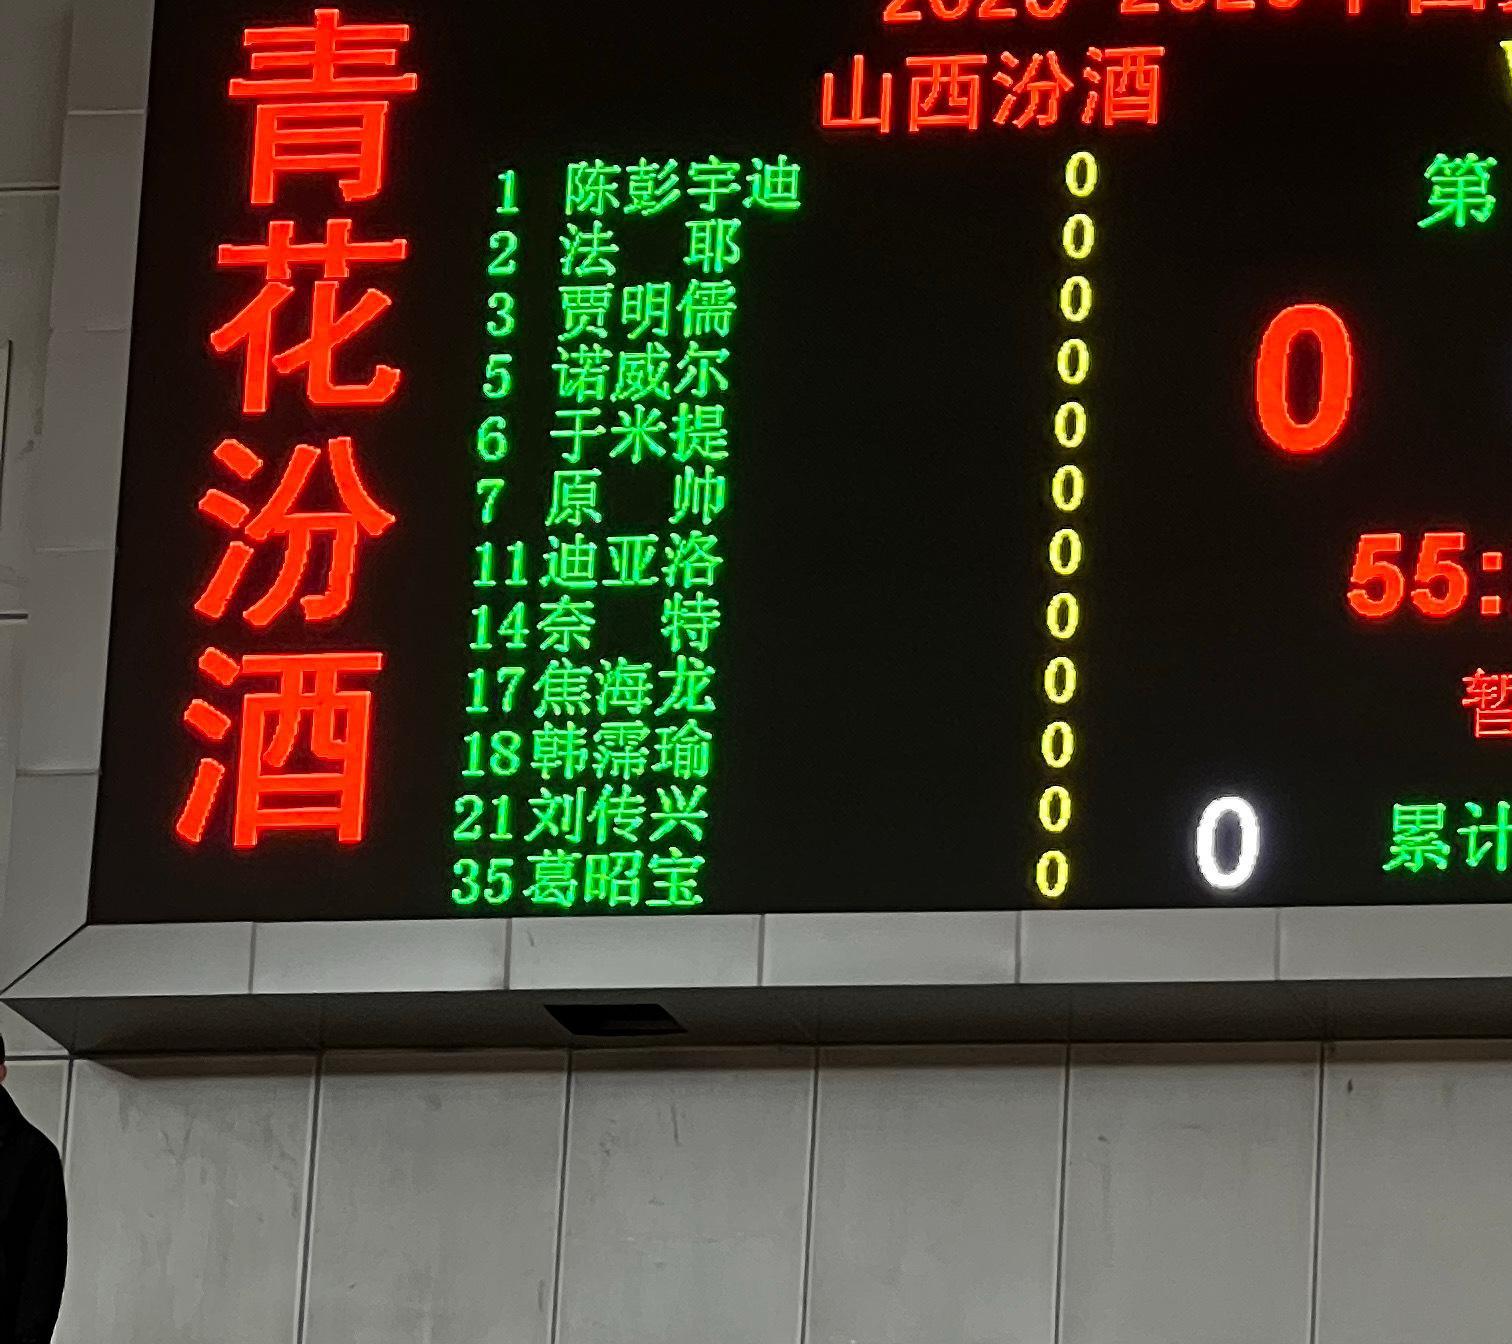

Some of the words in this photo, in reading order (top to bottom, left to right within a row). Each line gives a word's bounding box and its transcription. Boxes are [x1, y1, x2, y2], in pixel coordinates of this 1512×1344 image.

[821, 46, 1165, 134] 山西汾酒
[496, 170, 519, 214] 1
[565, 154, 801, 216] 陈彭宇迪
[1066, 153, 1097, 196] 0
[488, 231, 517, 275] 2
[1063, 216, 1094, 258] 0
[487, 292, 514, 336] 3
[558, 279, 737, 342] 贾明儒
[1061, 278, 1092, 321] 0
[483, 354, 512, 398] 5
[552, 341, 730, 403] 诺威尔
[1058, 341, 1089, 384] 0
[1255, 303, 1354, 454] 0
[176, 8, 418, 849] 青花汾酒
[477, 416, 507, 462] 6
[550, 402, 729, 464] 于米提
[1055, 403, 1086, 448] 0
[477, 479, 504, 523] 7
[1052, 465, 1084, 511] 0
[473, 541, 528, 586] 11
[539, 530, 723, 589] 迪亚洛
[1050, 531, 1081, 575] 0
[470, 602, 529, 649] 14
[1047, 593, 1078, 638] 0
[466, 667, 526, 713] 17
[533, 655, 716, 718] 焦海龙
[1045, 659, 1076, 703] 0
[462, 731, 522, 776] 18
[1042, 723, 1074, 768] 0
[454, 795, 512, 841] 21
[524, 784, 708, 845] 刘传兴
[1039, 786, 1071, 832] 0
[1197, 796, 1260, 889] 0
[452, 858, 513, 904] 35
[523, 847, 705, 907] 葛昭宝
[1036, 854, 1068, 897] 0
